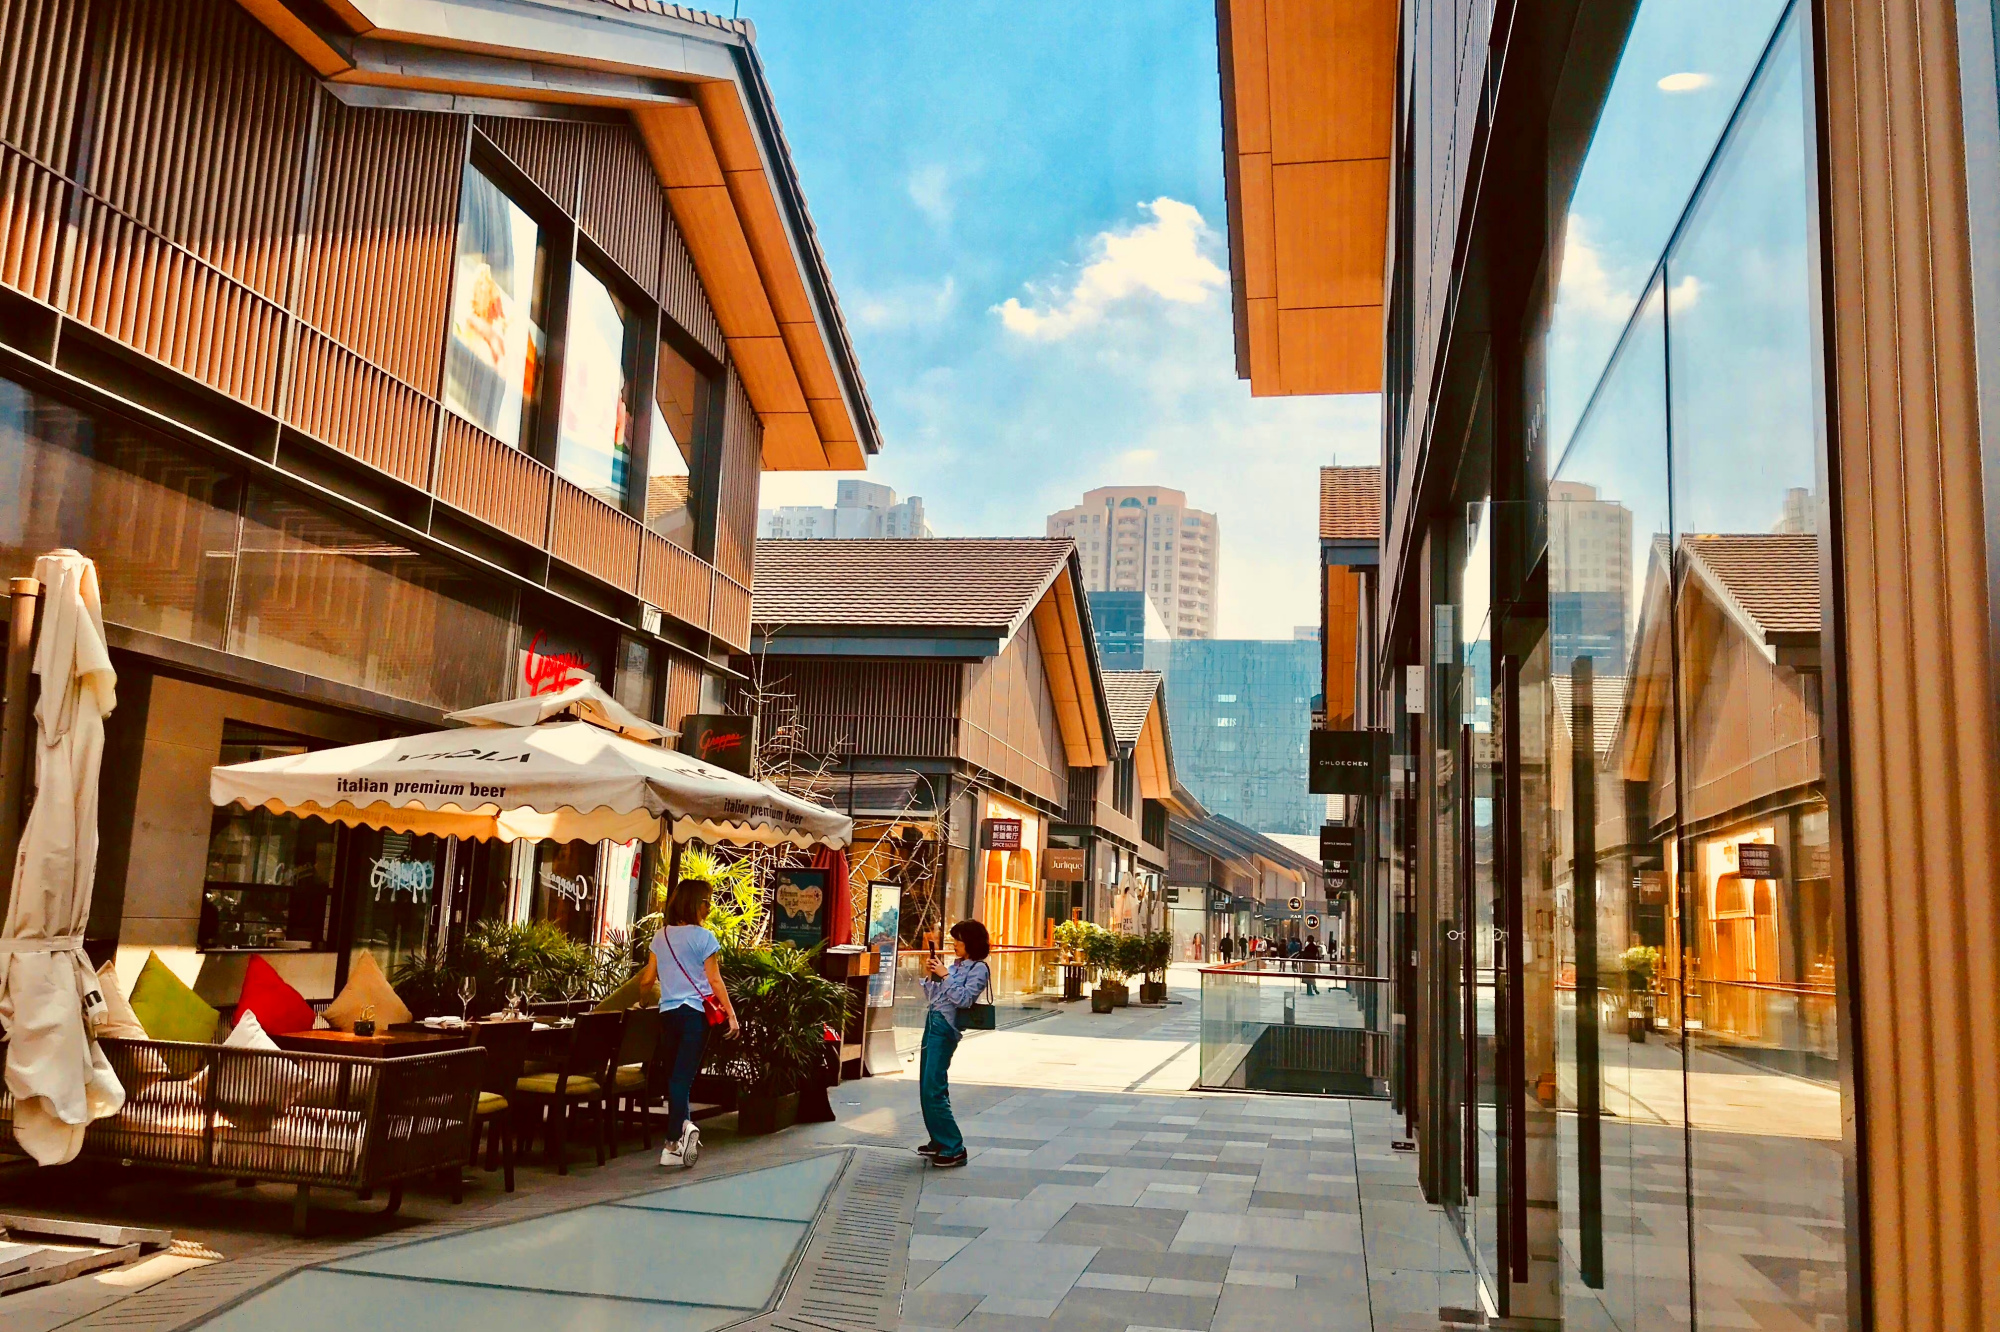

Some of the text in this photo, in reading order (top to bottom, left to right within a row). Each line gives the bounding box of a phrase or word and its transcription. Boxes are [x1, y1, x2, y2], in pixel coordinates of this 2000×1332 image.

[337, 778, 507, 798] italian premium beer
[723, 798, 803, 825] italian premium beer
[1051, 860, 1083, 873] Jurlique
